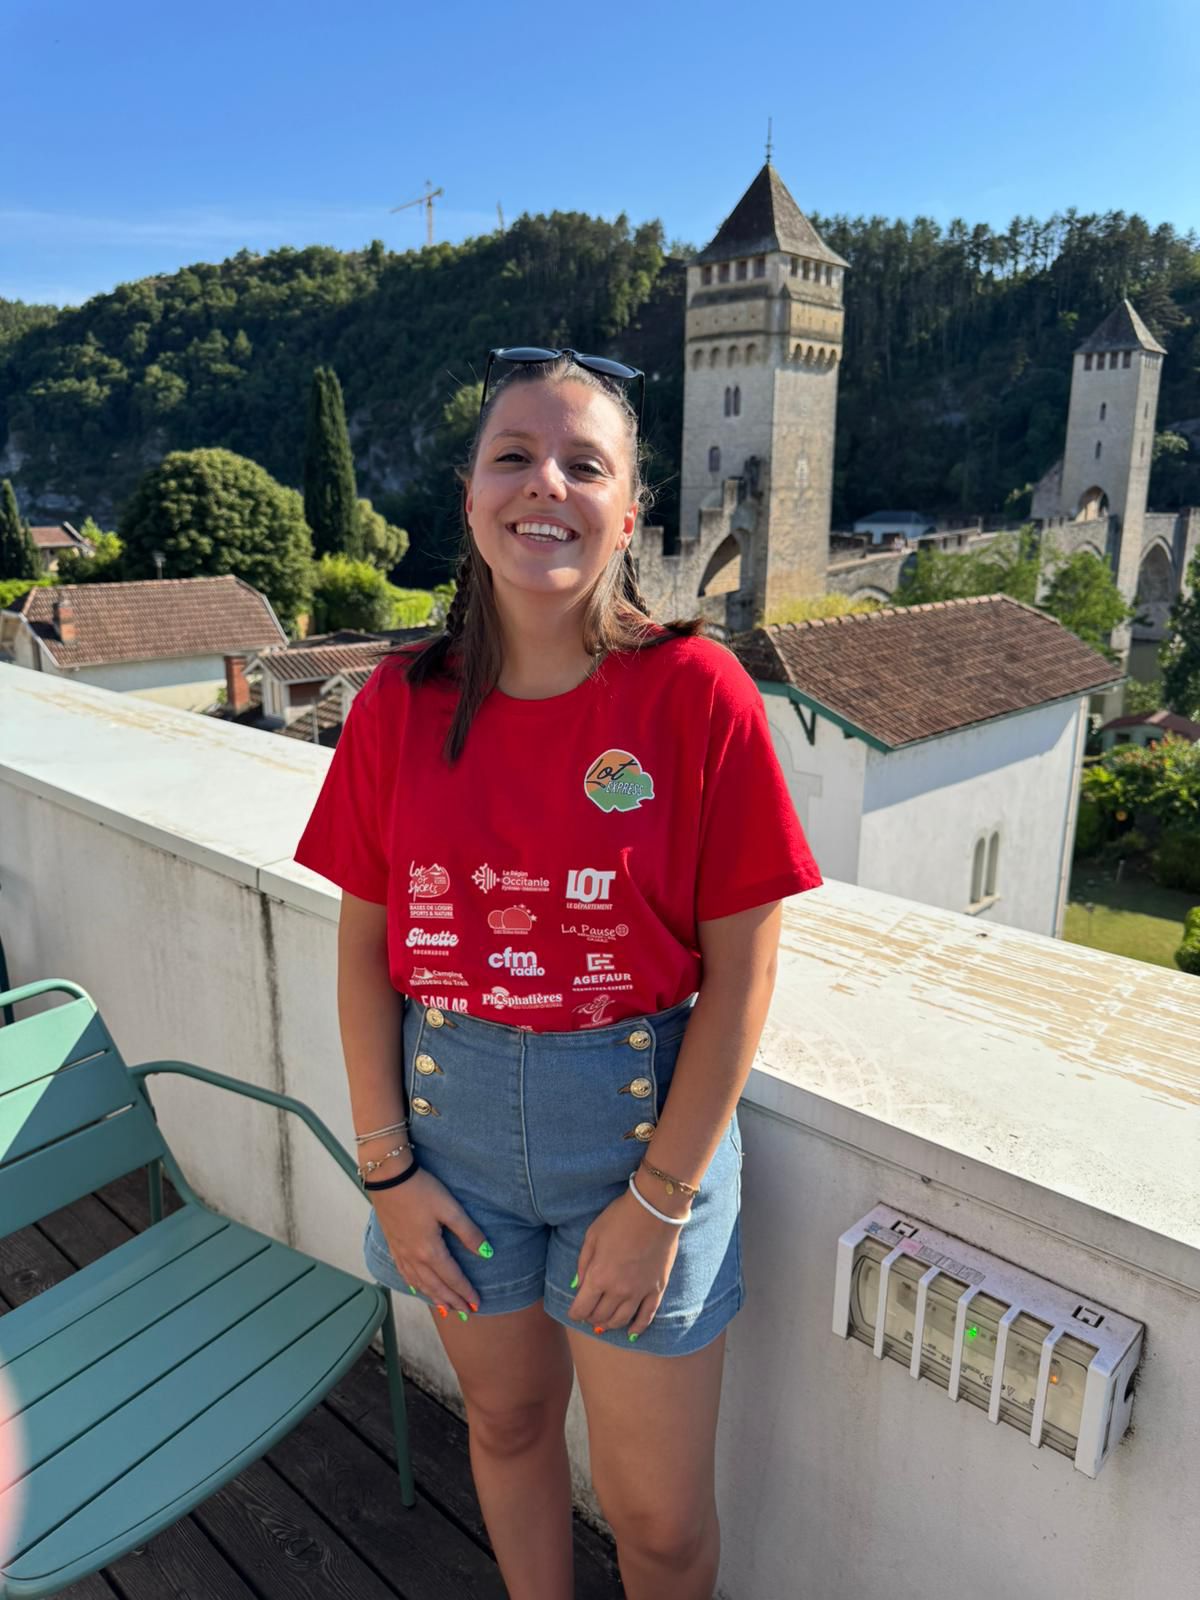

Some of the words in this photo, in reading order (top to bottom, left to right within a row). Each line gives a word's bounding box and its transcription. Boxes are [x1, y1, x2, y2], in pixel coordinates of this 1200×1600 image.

[586, 758, 638, 788] Lot
[605, 781, 643, 796] EXPRESS
[502, 876, 550, 887] Occitanie
[565, 867, 617, 903] LOT
[573, 902, 613, 910] DÉPARTEMENT
[561, 923, 577, 934] La
[581, 924, 616, 937] Pause
[405, 927, 460, 948] Ginette
[488, 946, 537, 968] cfm
[432, 970, 463, 979] Camping
[510, 965, 546, 976] radio
[572, 973, 632, 985] AGEFAUR
